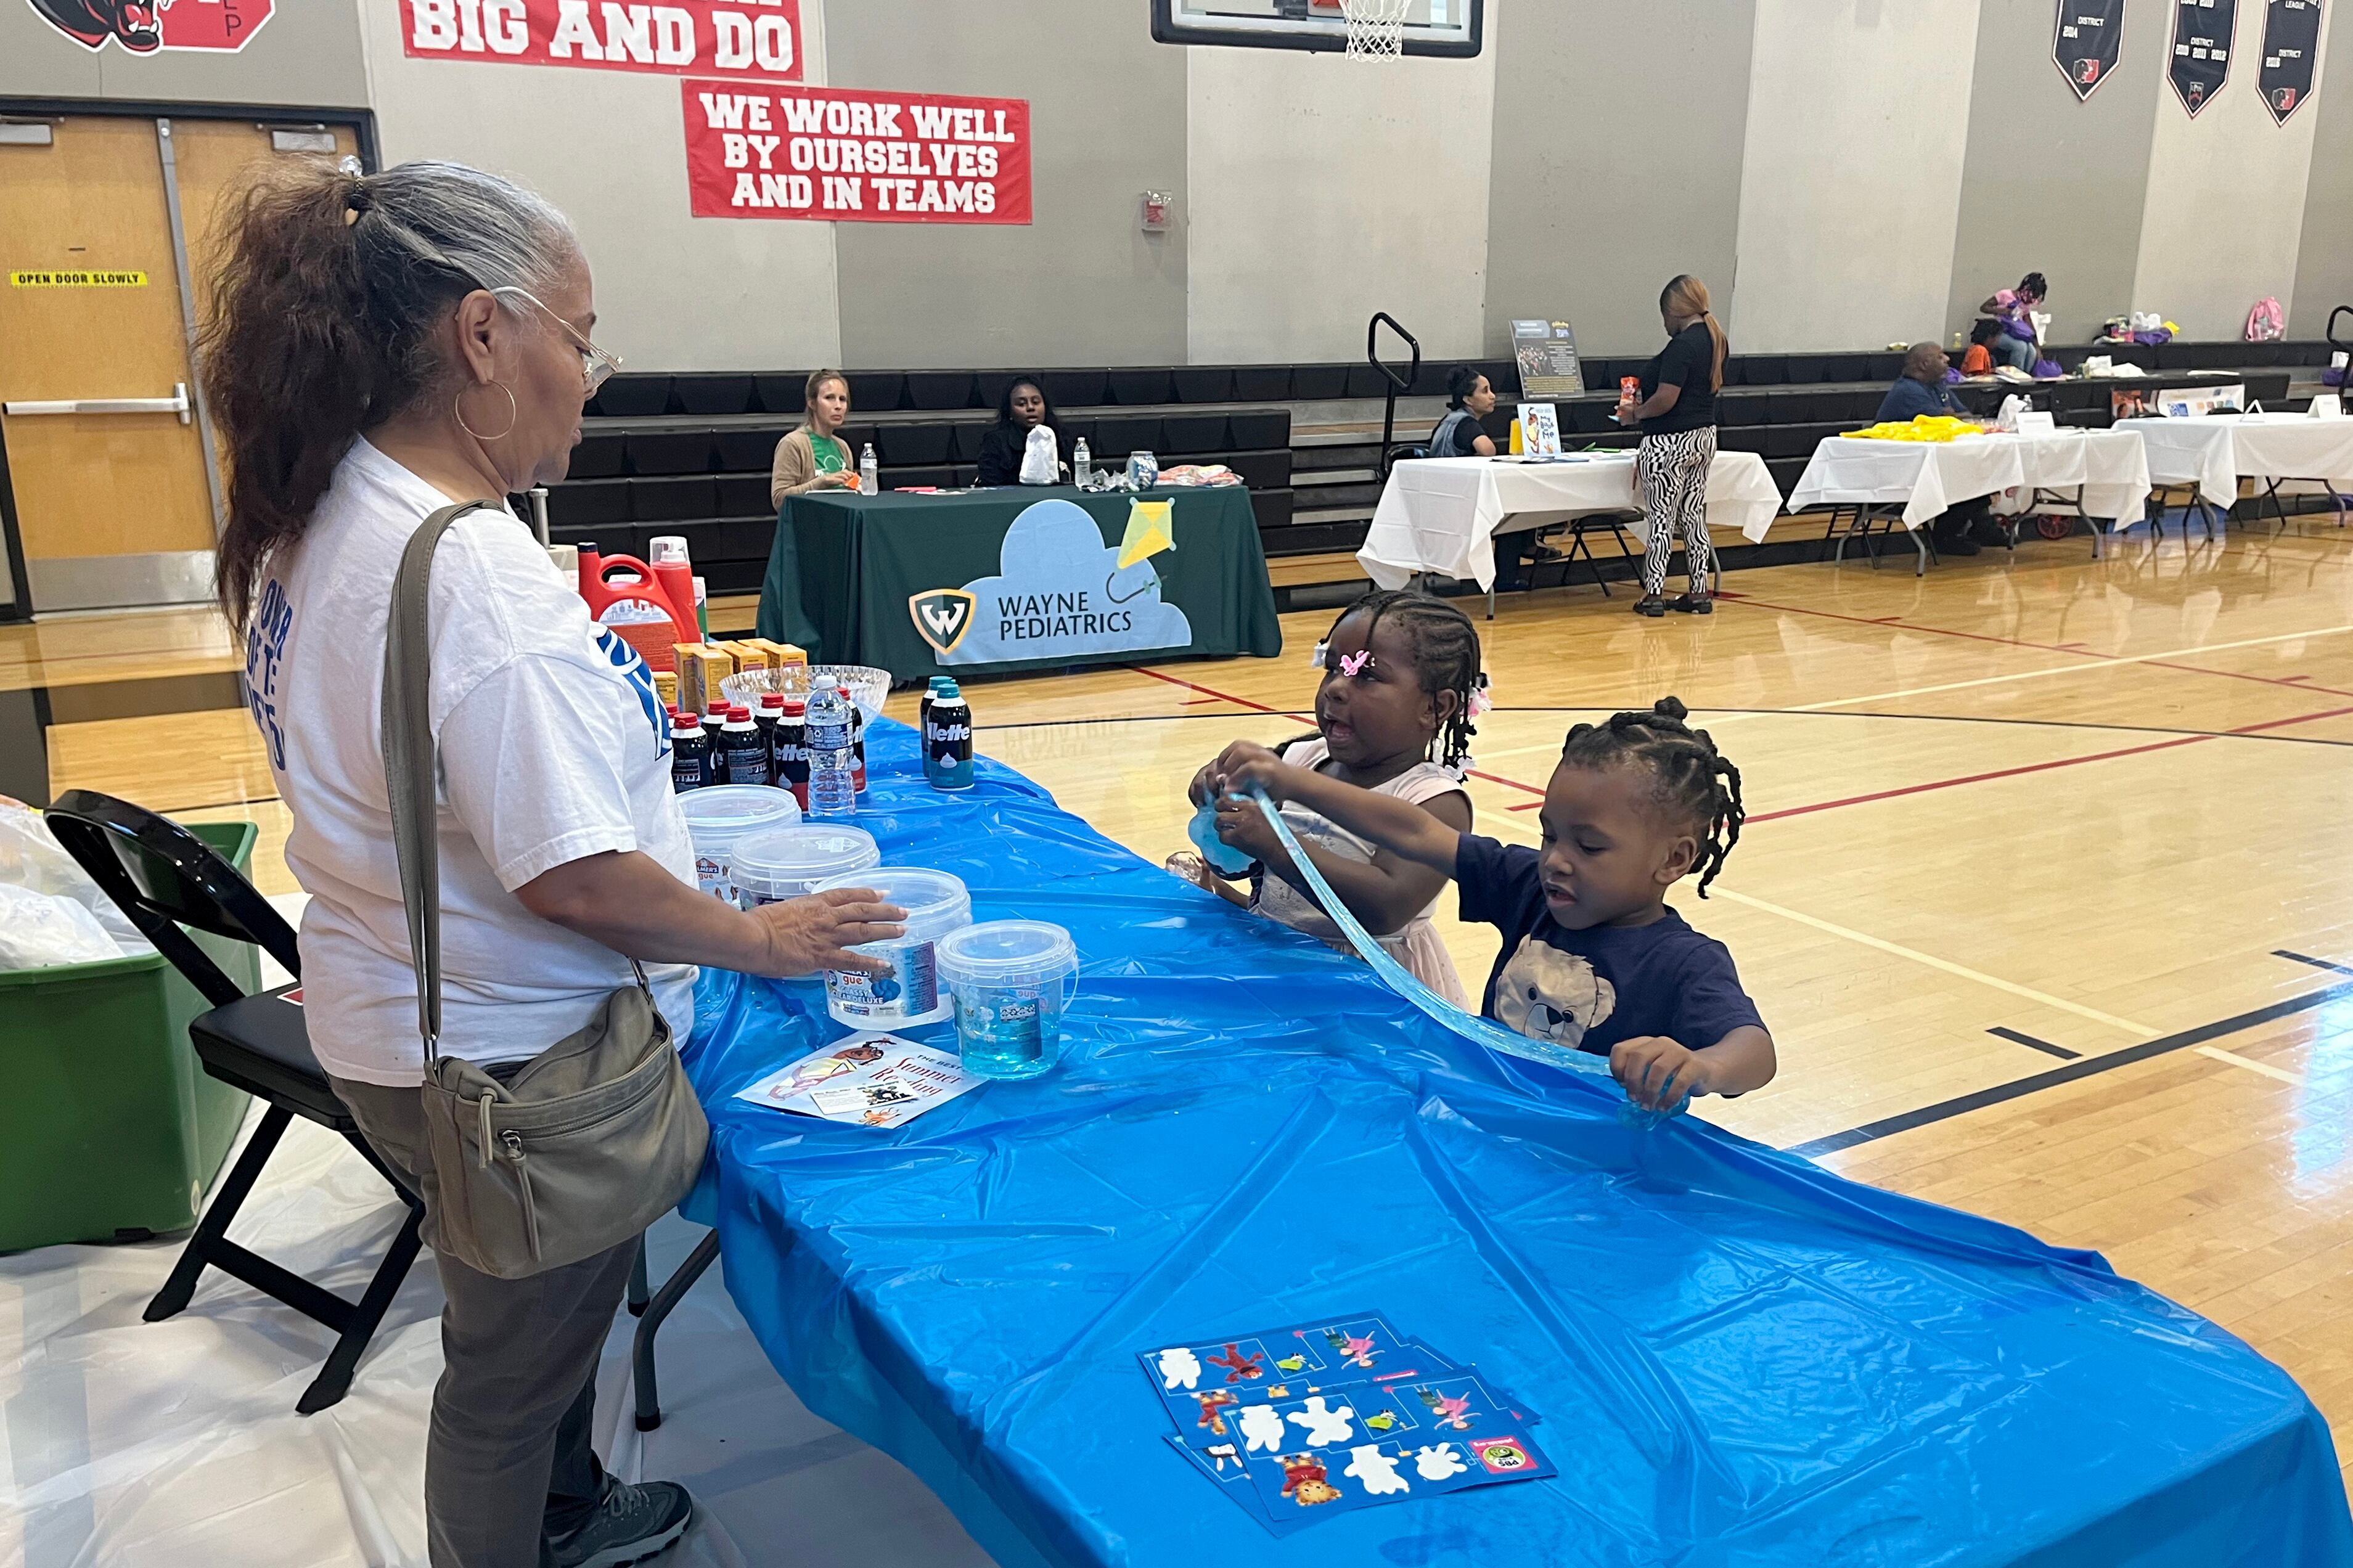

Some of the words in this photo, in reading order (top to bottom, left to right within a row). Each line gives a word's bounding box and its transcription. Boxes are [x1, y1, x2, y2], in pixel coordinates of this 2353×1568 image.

[2077, 16, 2105, 27] DISTRICT
[412, 0, 530, 55] BIG
[549, 0, 697, 66] AND
[711, 10, 794, 72] DO
[698, 92, 773, 131] WE
[780, 97, 903, 137] WORK
[909, 105, 1016, 143] WELL
[722, 133, 781, 169] BY
[789, 136, 999, 178] OURSELVES
[730, 173, 814, 209] AND
[821, 176, 863, 211] IN
[870, 178, 996, 213] TEAMS
[18, 274, 51, 284] OPEN
[55, 274, 88, 284] DOOR
[92, 274, 139, 284] SLOWLY
[998, 591, 1089, 618] WAYNE
[920, 602, 966, 636] W
[1000, 610, 1132, 641] PEDIATRICS
[927, 722, 970, 741] llette
[697, 865, 719, 873] LMER'S
[839, 986, 870, 997] GLASSY
[843, 975, 863, 986] gue
[851, 995, 884, 1005] DELUXE
[894, 1057, 963, 1085] Summer
[917, 1054, 935, 1063] THE
[937, 1060, 963, 1071] BEST
[869, 1067, 944, 1098] Reding
